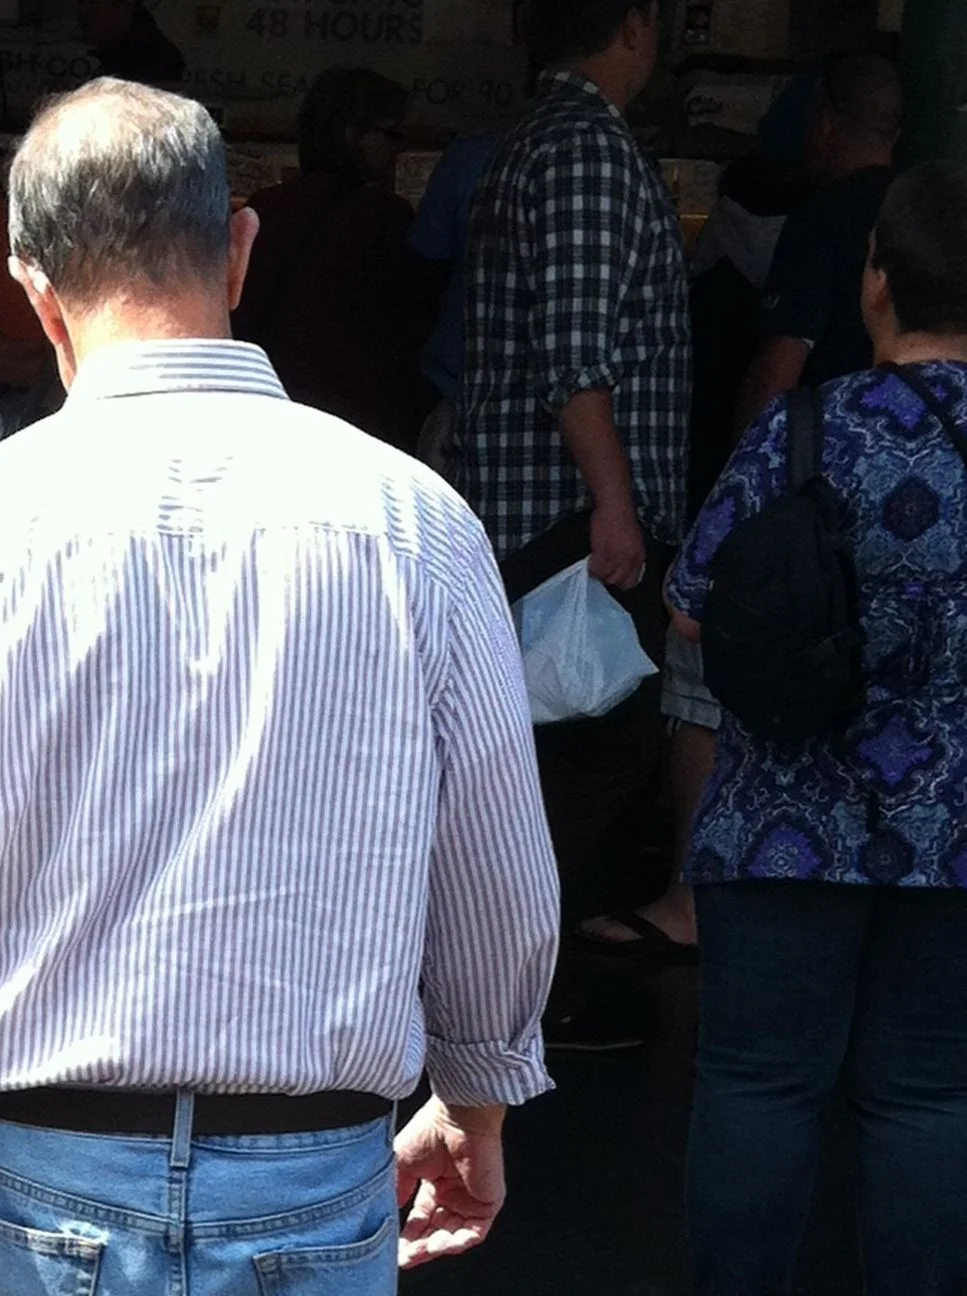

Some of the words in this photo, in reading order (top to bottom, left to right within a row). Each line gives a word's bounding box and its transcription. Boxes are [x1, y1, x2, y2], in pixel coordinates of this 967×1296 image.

[246, 8, 289, 37] 48
[303, 10, 423, 44] HOURS
[413, 77, 467, 105] FOR
